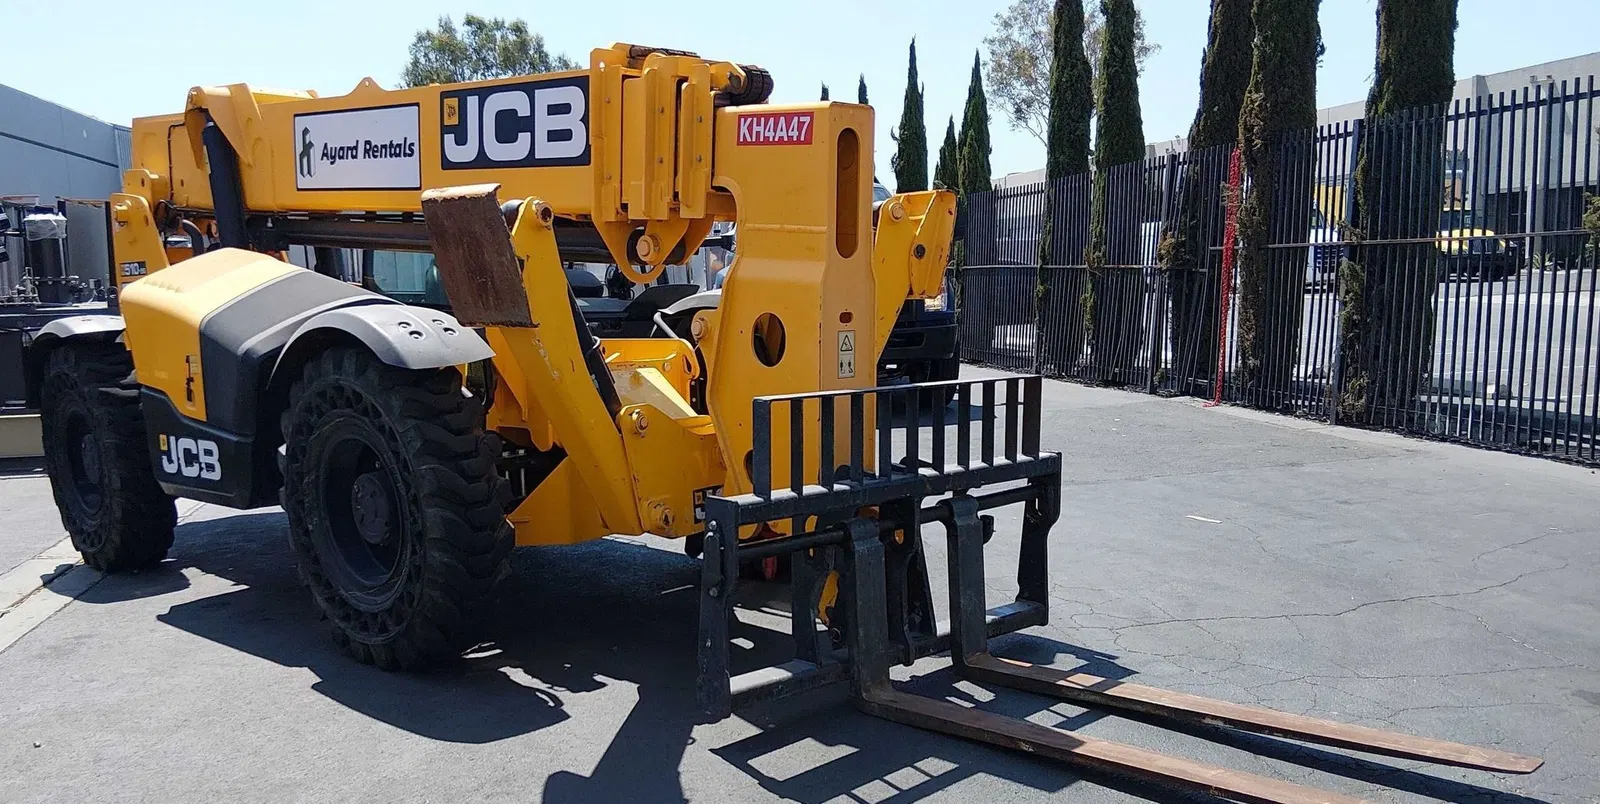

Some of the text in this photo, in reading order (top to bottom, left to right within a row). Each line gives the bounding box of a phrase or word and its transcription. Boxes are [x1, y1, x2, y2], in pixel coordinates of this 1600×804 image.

[443, 86, 587, 163] JCB
[740, 116, 811, 142] KH4A47
[320, 137, 415, 165] Ayard Rentals
[161, 436, 221, 480] JCB
